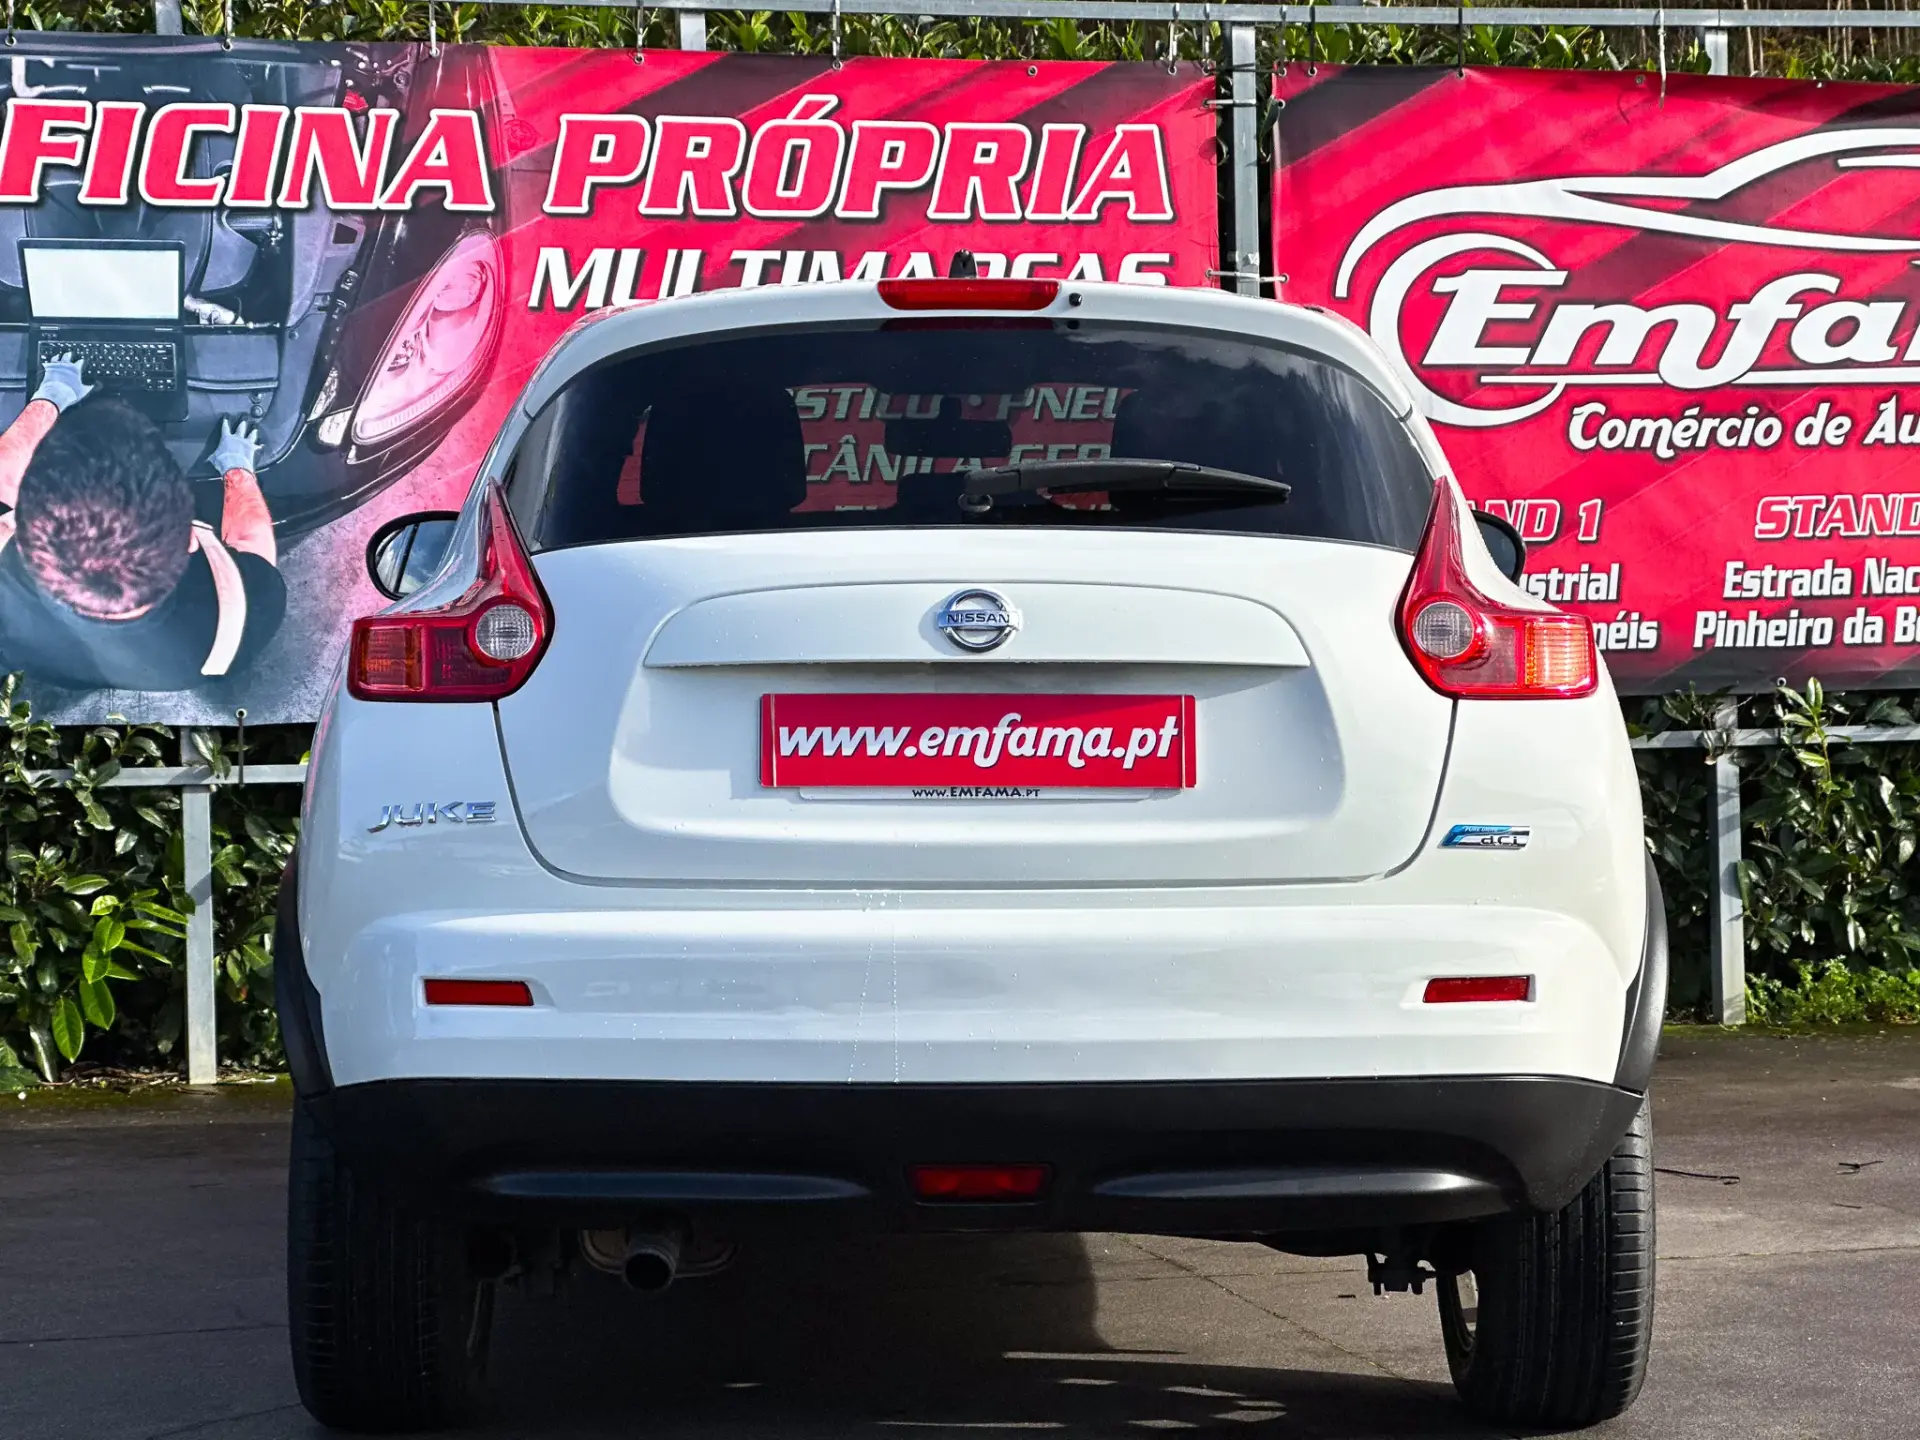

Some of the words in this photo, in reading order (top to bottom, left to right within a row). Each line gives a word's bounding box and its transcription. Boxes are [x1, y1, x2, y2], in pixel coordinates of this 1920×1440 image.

[0, 98, 496, 211] FICINA
[542, 94, 1175, 221] PRÓPRIA
[1421, 269, 1920, 389] Emfa
[1568, 402, 1783, 459] Comércio
[1794, 402, 1852, 446] de
[1577, 498, 1602, 541] 1
[1722, 559, 1852, 598] Estrada
[1861, 556, 1920, 595] Nac
[946, 612, 1010, 624] NISSAN
[1693, 609, 1834, 648] Pinheiro
[1843, 606, 1884, 645] da
[1893, 605, 1920, 643] B
[778, 712, 1180, 770] www.emfama.pt
[366, 800, 497, 834] JUKE
